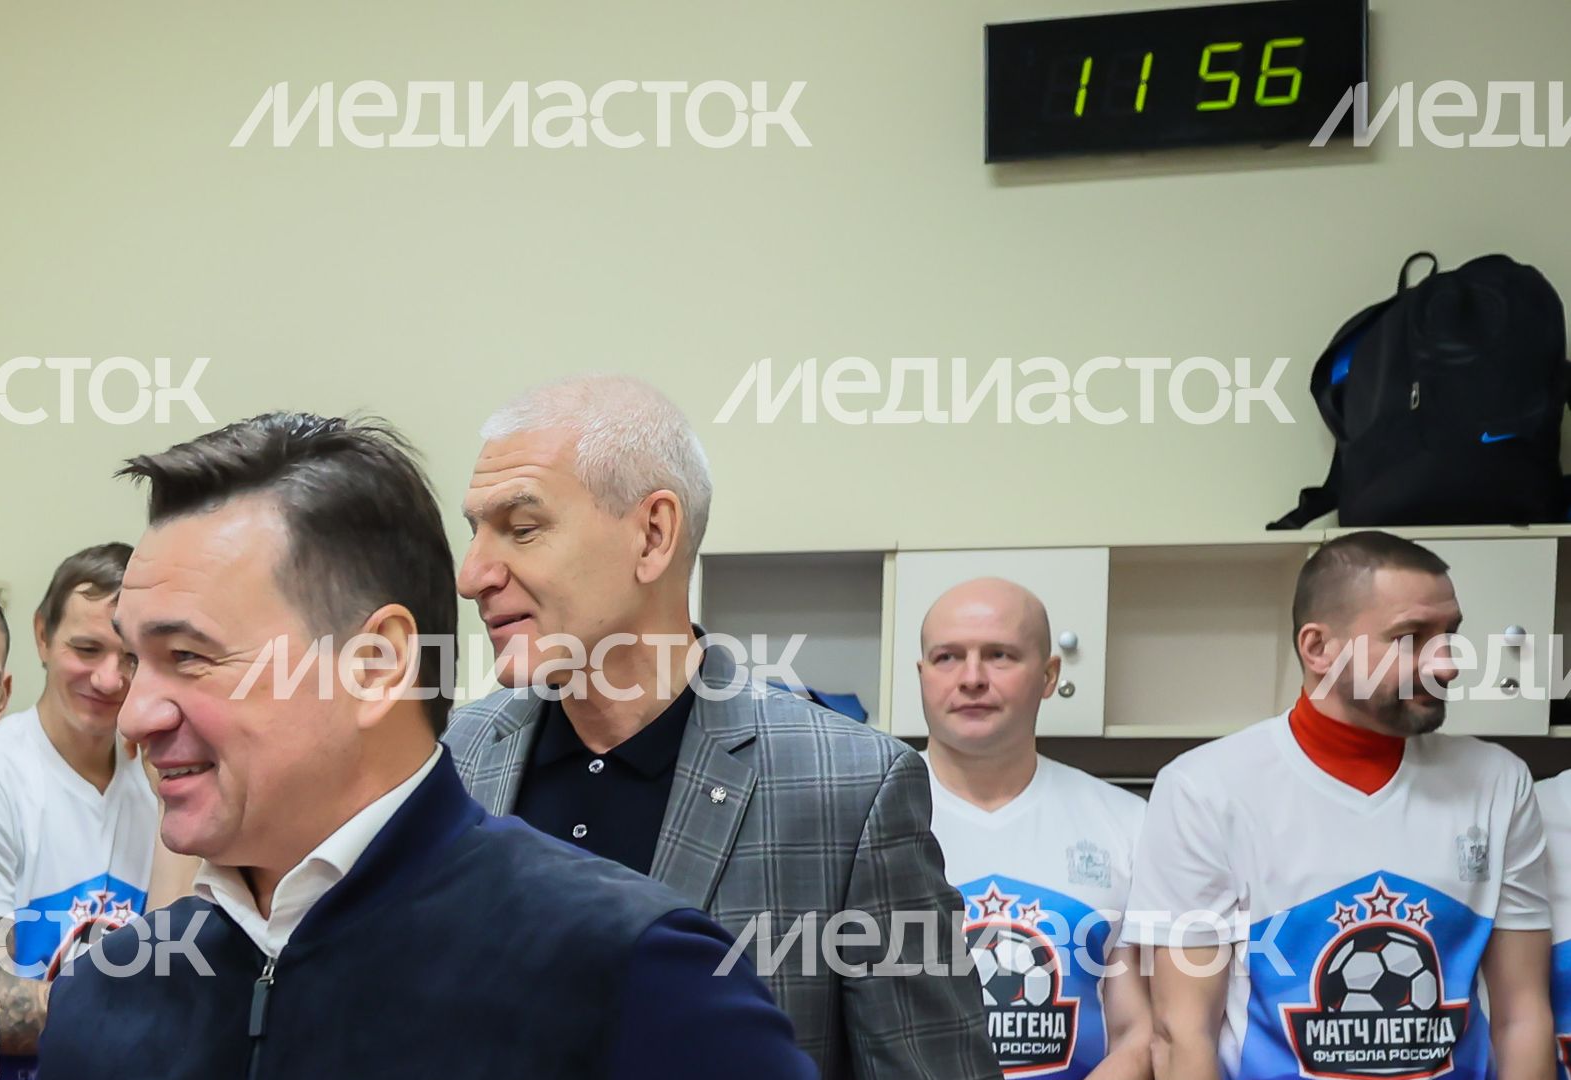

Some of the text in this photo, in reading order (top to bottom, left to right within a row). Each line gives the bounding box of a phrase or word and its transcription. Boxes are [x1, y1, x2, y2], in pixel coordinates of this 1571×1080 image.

[989, 1011, 1067, 1039] ЛЕГЕНД
[1306, 1017, 1456, 1046] МАТЧ ЛЕГЕНД
[1000, 1042, 1061, 1055] РОССИИ
[1313, 1049, 1386, 1063] ФУТБОЛА
